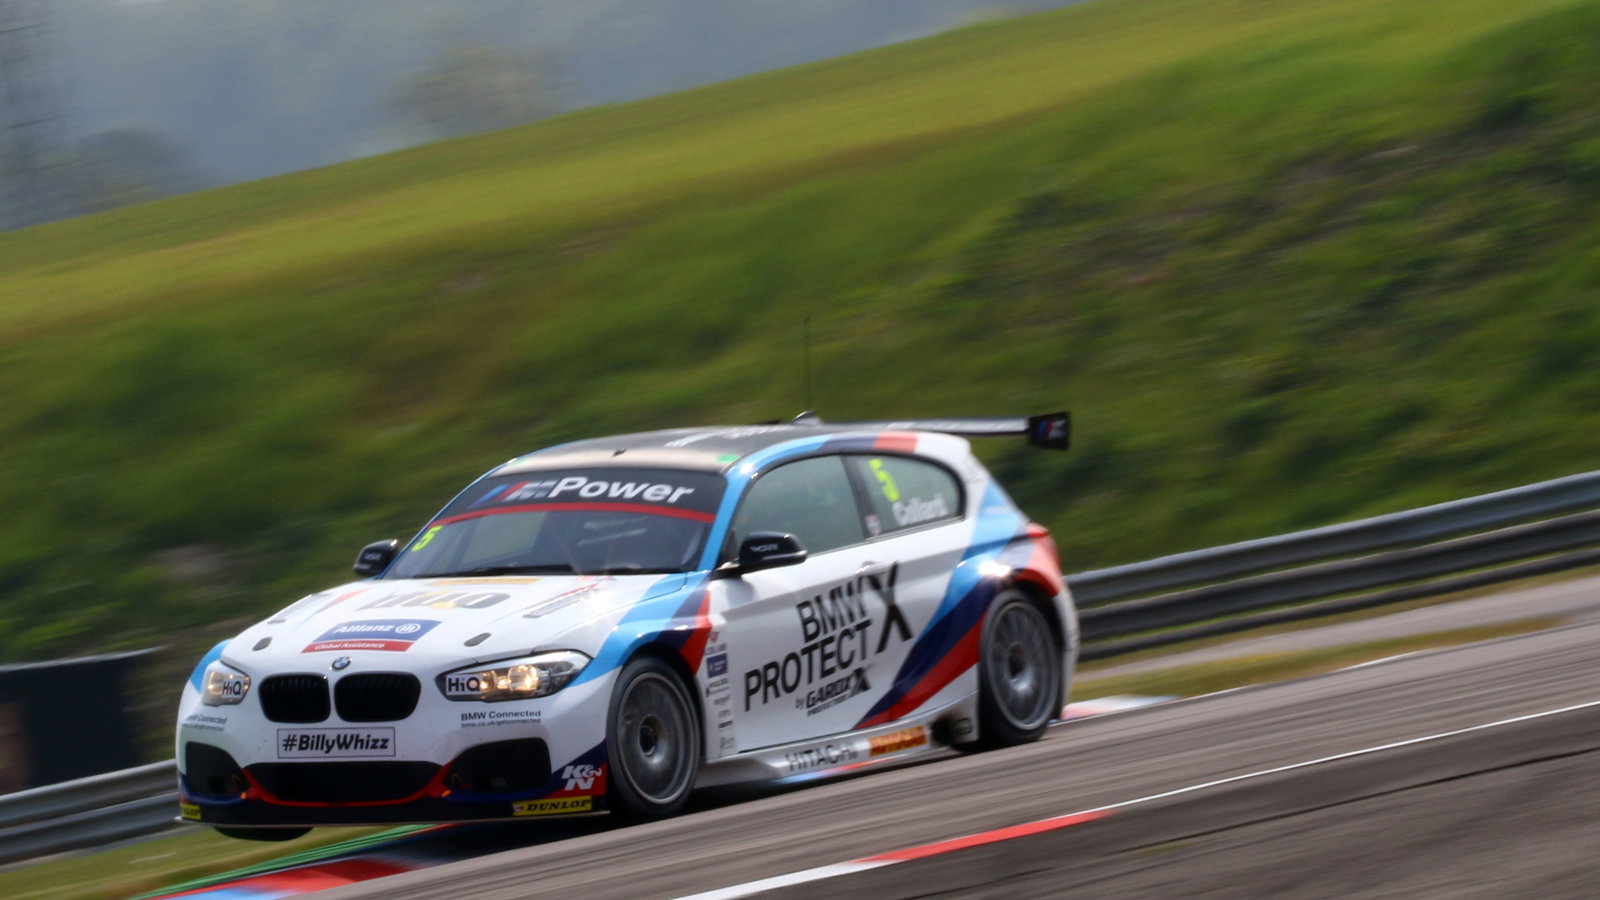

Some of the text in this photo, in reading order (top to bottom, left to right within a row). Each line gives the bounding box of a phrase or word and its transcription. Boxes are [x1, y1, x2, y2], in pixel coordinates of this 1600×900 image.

[869, 458, 899, 503] 5
[411, 525, 443, 552] 5
[796, 576, 870, 643] BMW
[333, 623, 395, 634] Allianz
[745, 561, 914, 712] PROTECT X
[222, 680, 242, 695] HiQ
[447, 677, 481, 692] HiQ
[461, 710, 541, 721] BMW Connected
[282, 733, 389, 754] #BillyWhizz
[526, 799, 591, 812] DUNLOP
